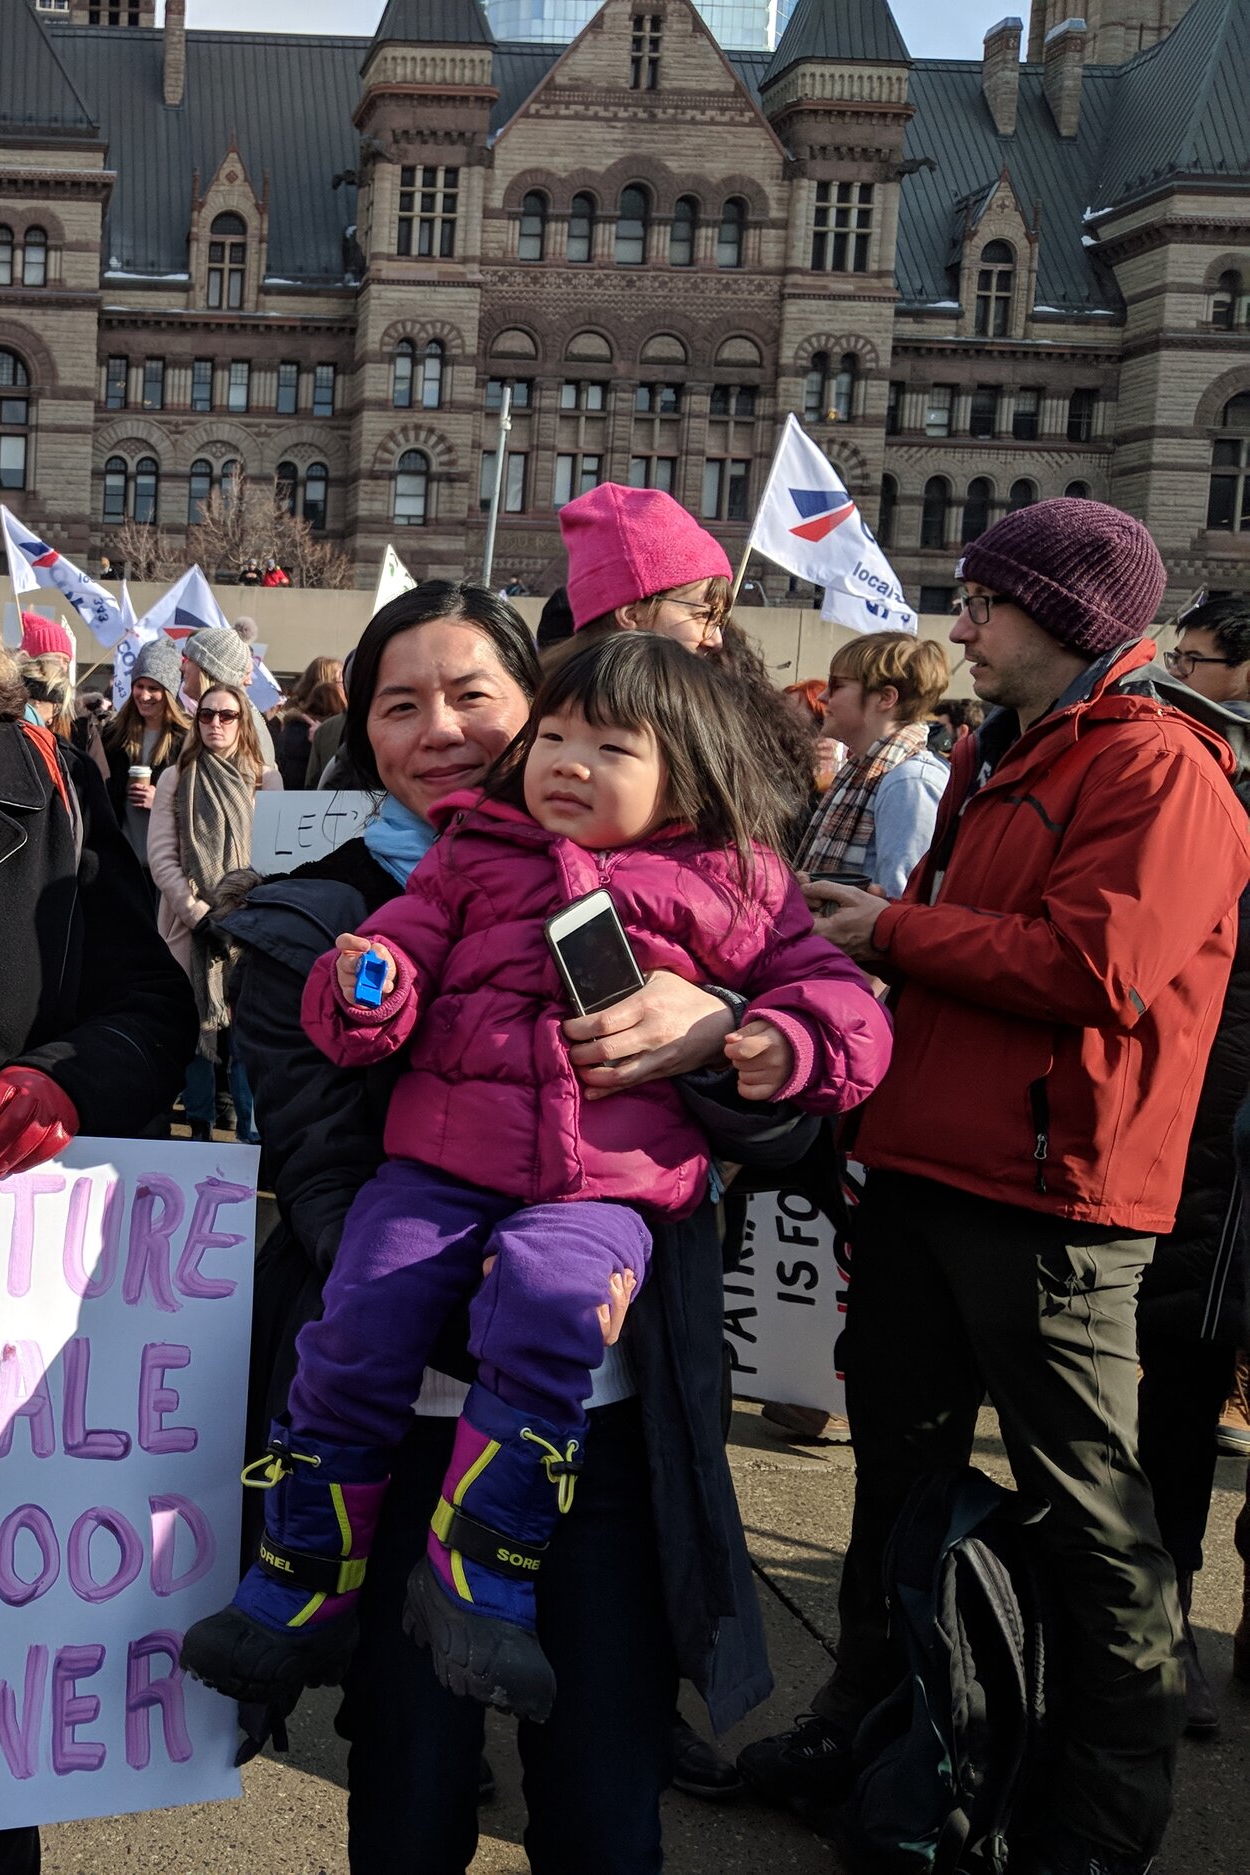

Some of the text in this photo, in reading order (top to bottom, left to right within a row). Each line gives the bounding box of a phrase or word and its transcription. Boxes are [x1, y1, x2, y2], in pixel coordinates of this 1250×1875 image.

[775, 1187, 820, 1306] IS FO
[259, 1545, 295, 1574] OREL
[496, 1547, 541, 1570] SORE
